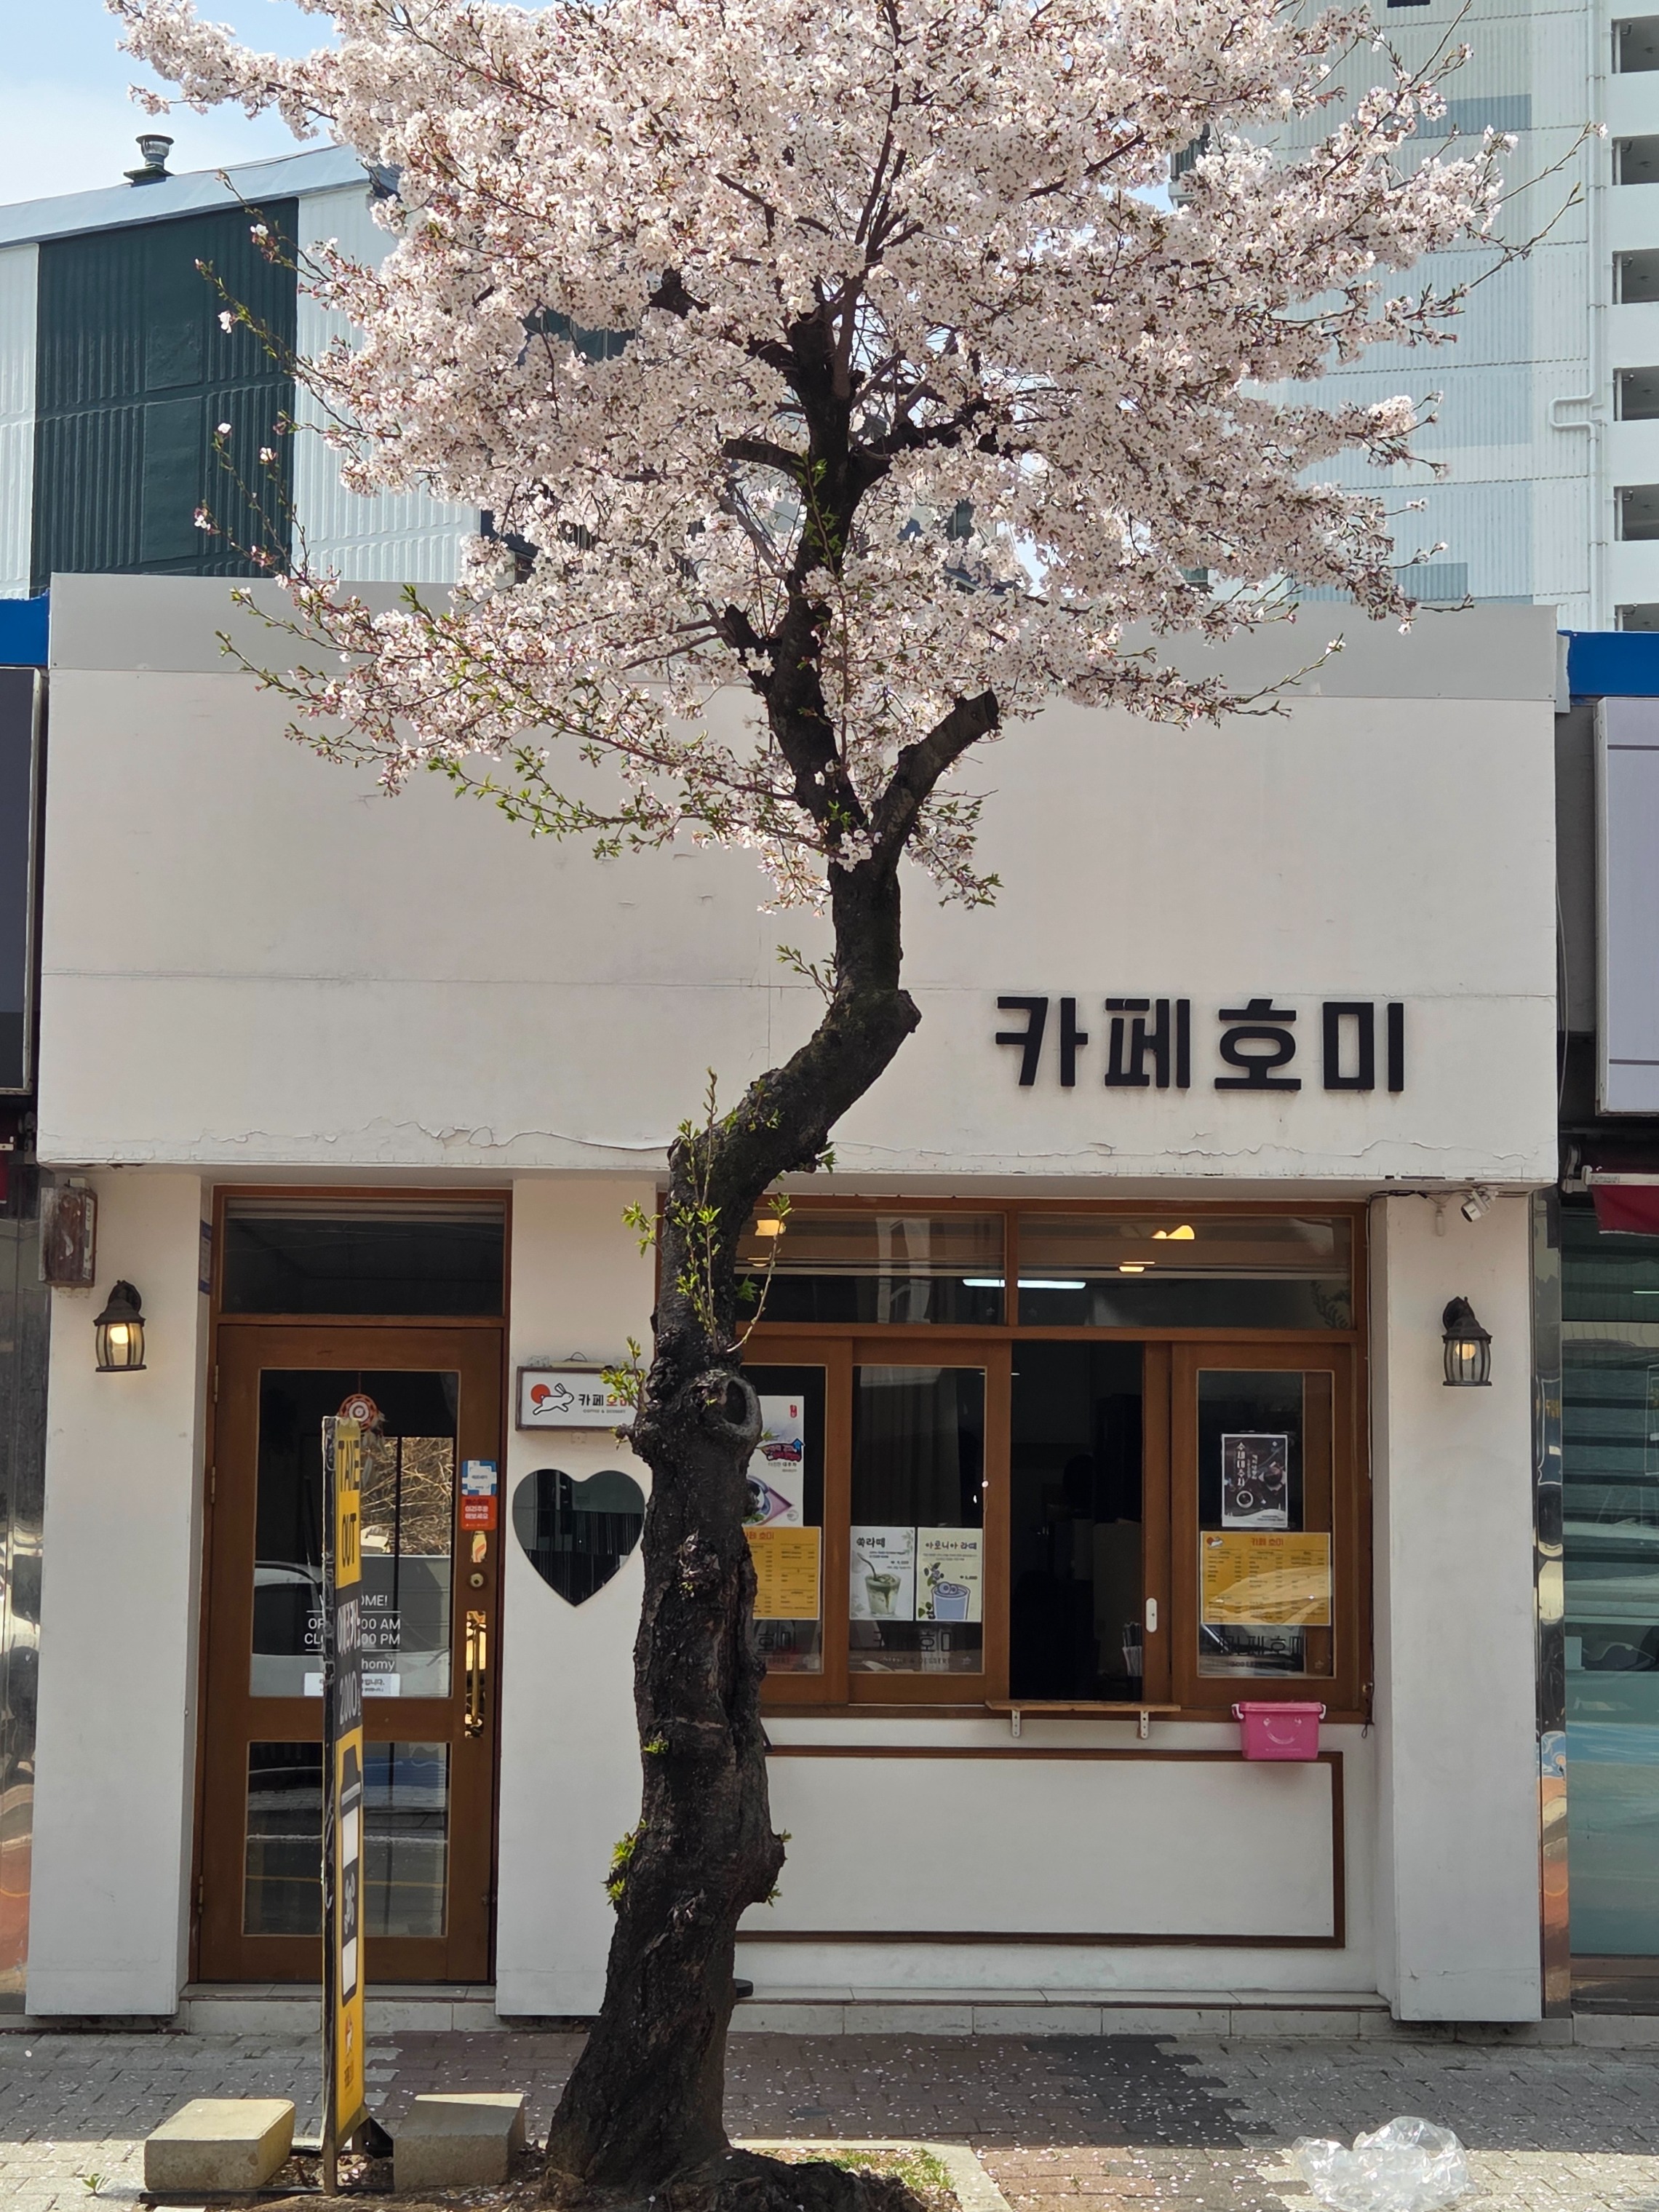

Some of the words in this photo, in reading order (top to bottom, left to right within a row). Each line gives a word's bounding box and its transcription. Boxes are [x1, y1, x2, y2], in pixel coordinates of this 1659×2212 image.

[995, 996, 1404, 1092] 카페호미
[338, 1440, 359, 1492] TAKE
[341, 1513, 357, 1568] OUT
[856, 1537, 886, 1548] 쑥라떼
[380, 1618, 401, 1629] AM
[381, 1634, 401, 1644] PM
